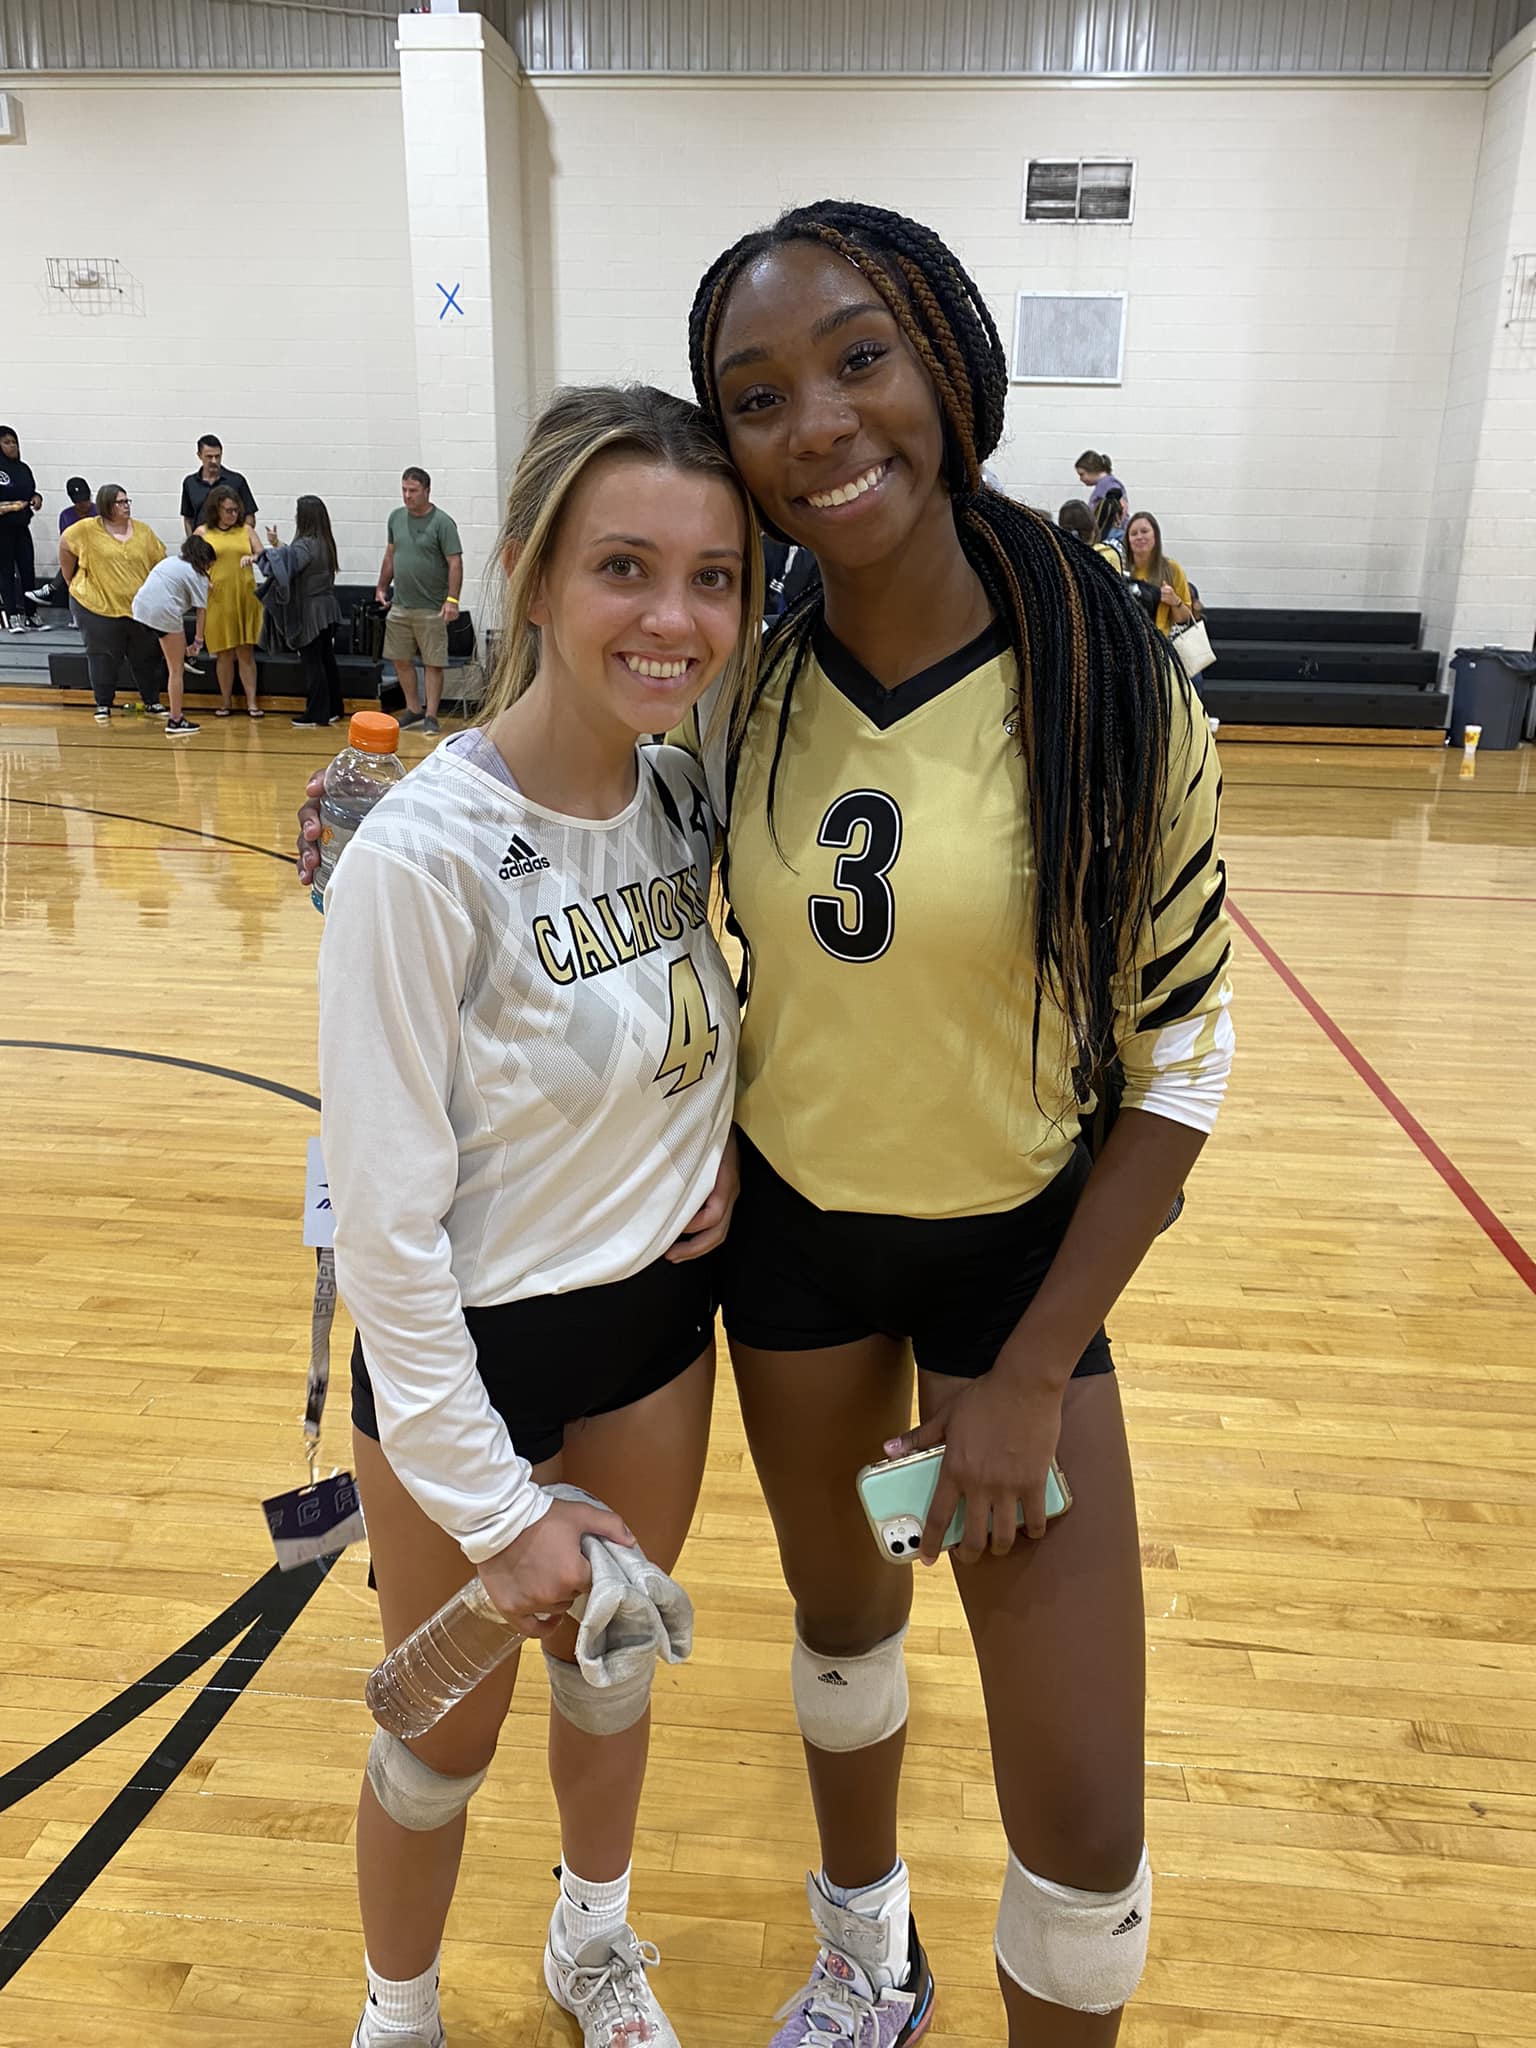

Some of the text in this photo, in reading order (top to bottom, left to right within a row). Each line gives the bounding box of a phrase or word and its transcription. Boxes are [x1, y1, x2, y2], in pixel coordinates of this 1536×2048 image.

[499, 857, 551, 880] adidas
[808, 788, 903, 963] 3
[653, 953, 719, 1099] 4
